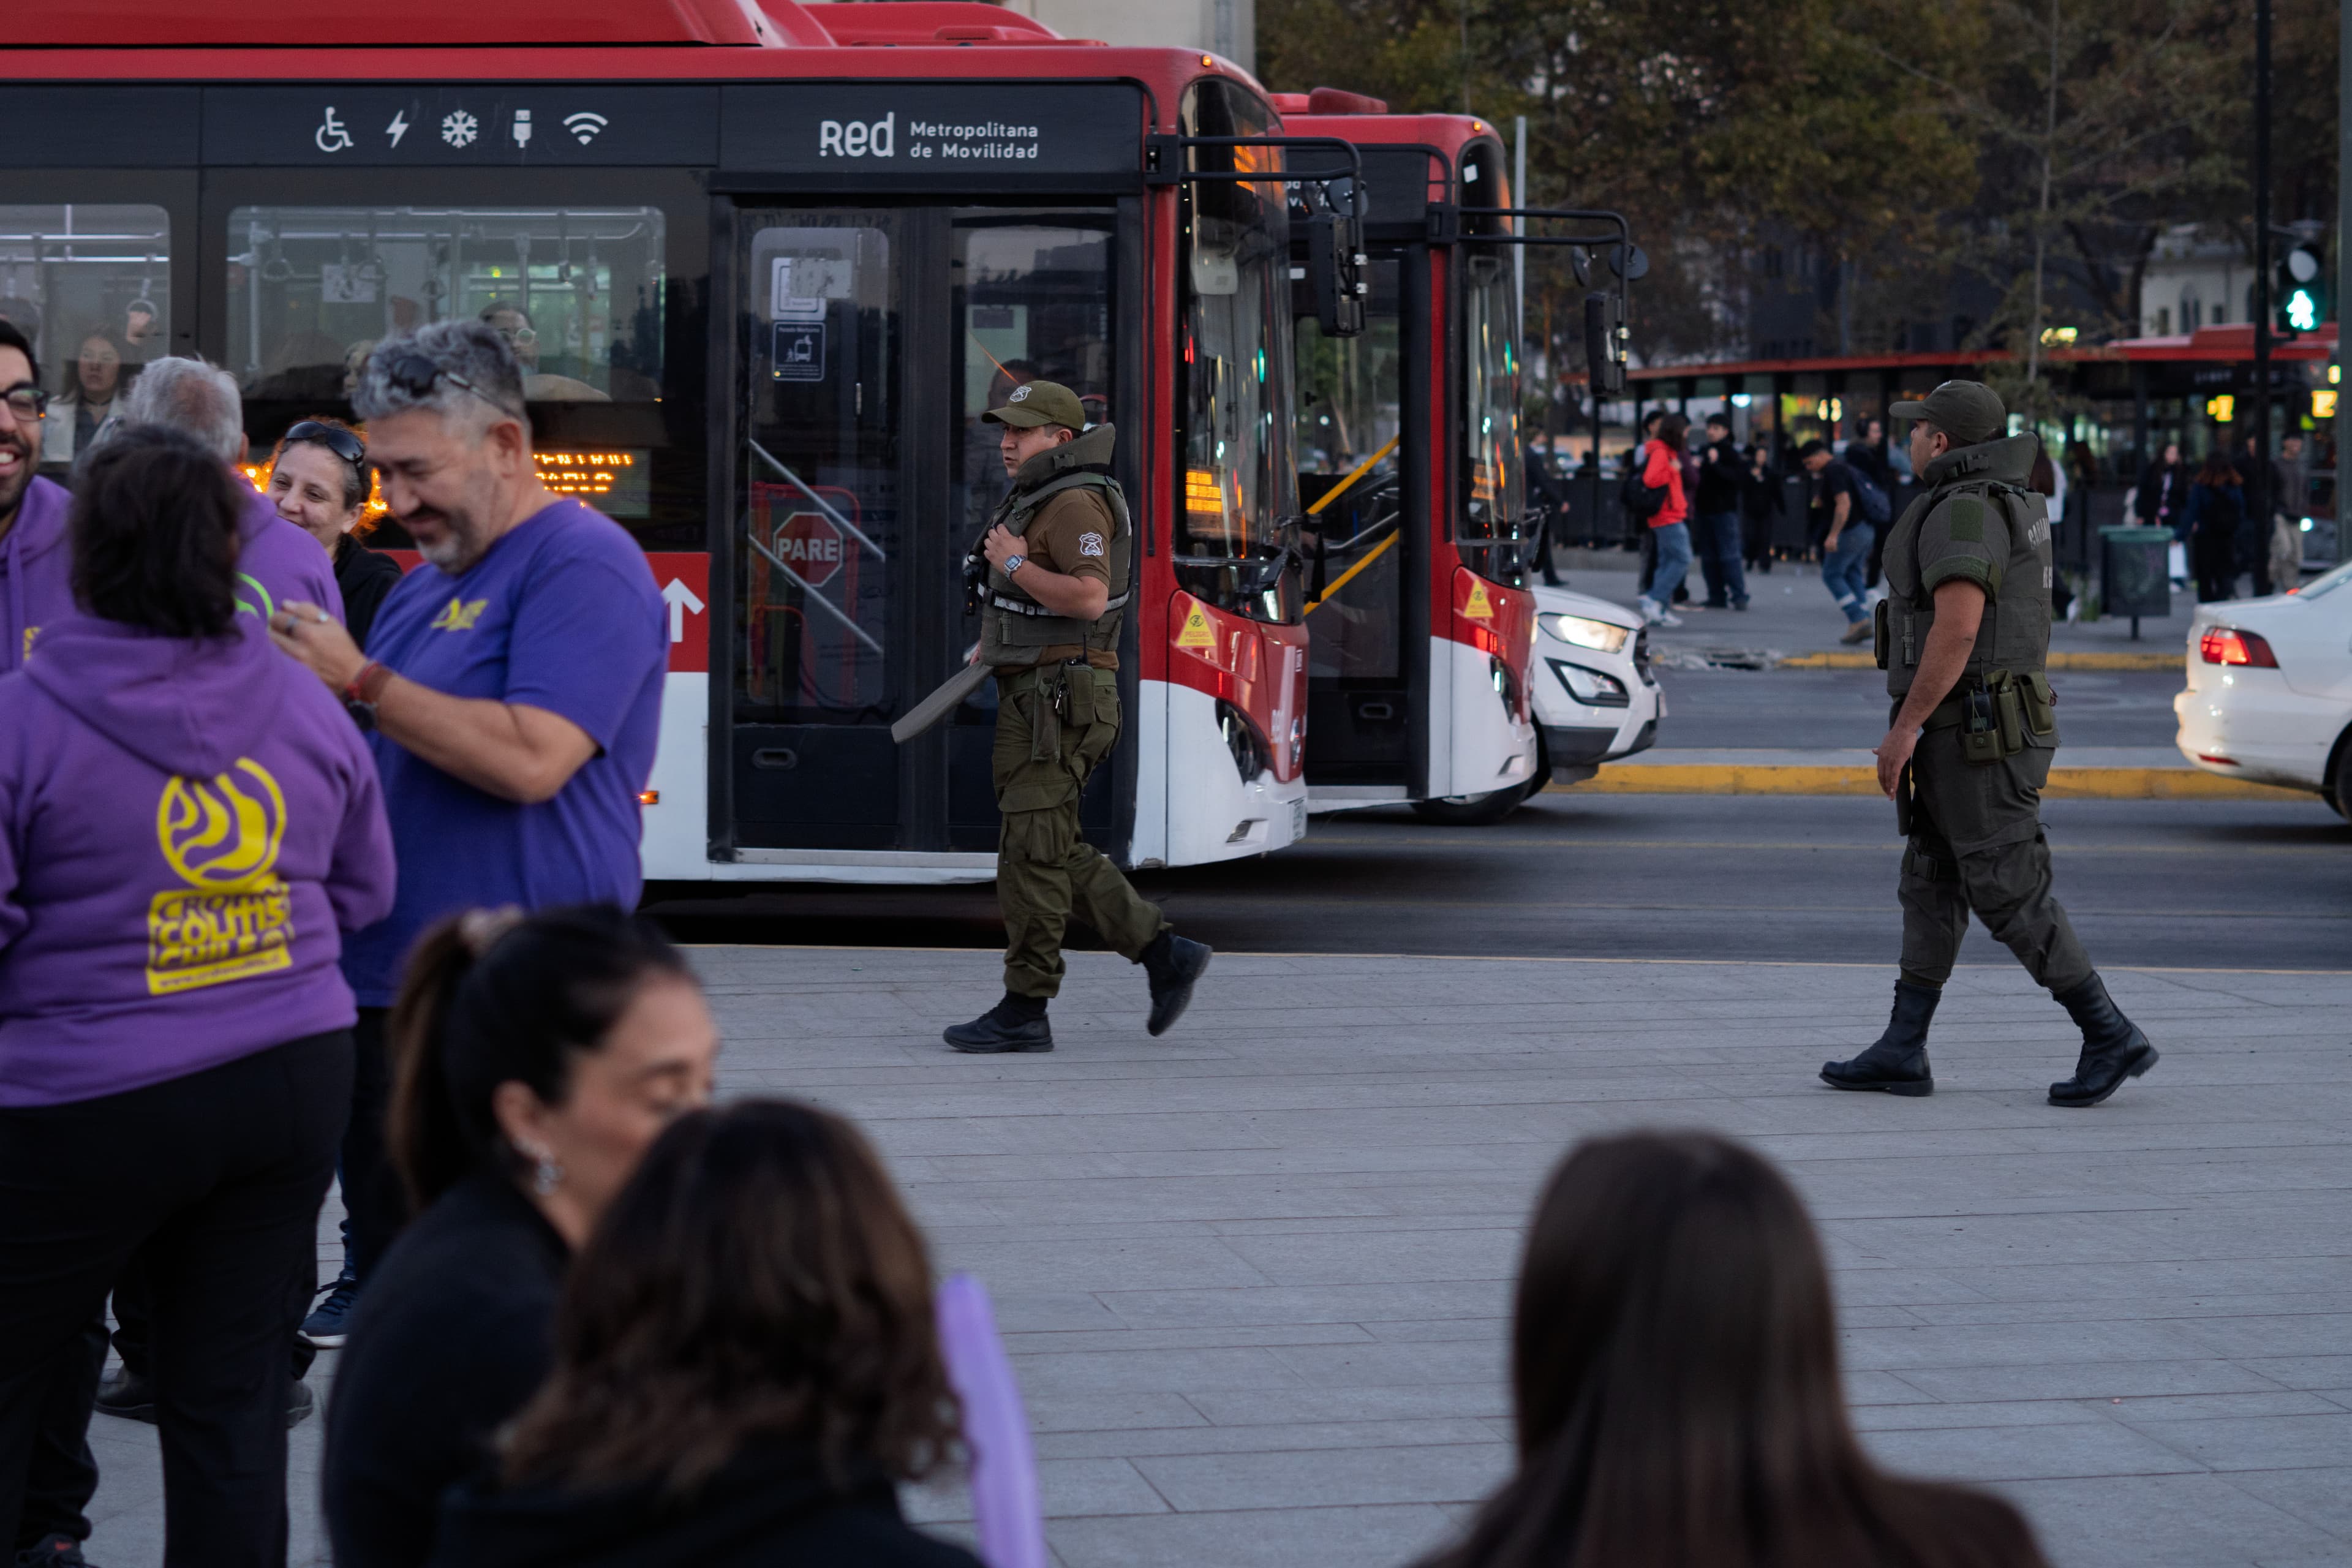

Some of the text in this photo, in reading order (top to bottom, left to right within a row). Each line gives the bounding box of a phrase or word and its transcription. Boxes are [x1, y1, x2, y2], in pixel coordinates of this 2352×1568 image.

[820, 111, 894, 157] Red
[910, 121, 1038, 140] Metropolitana
[910, 142, 1038, 159] de Movilidad
[778, 538, 839, 562] PARE
